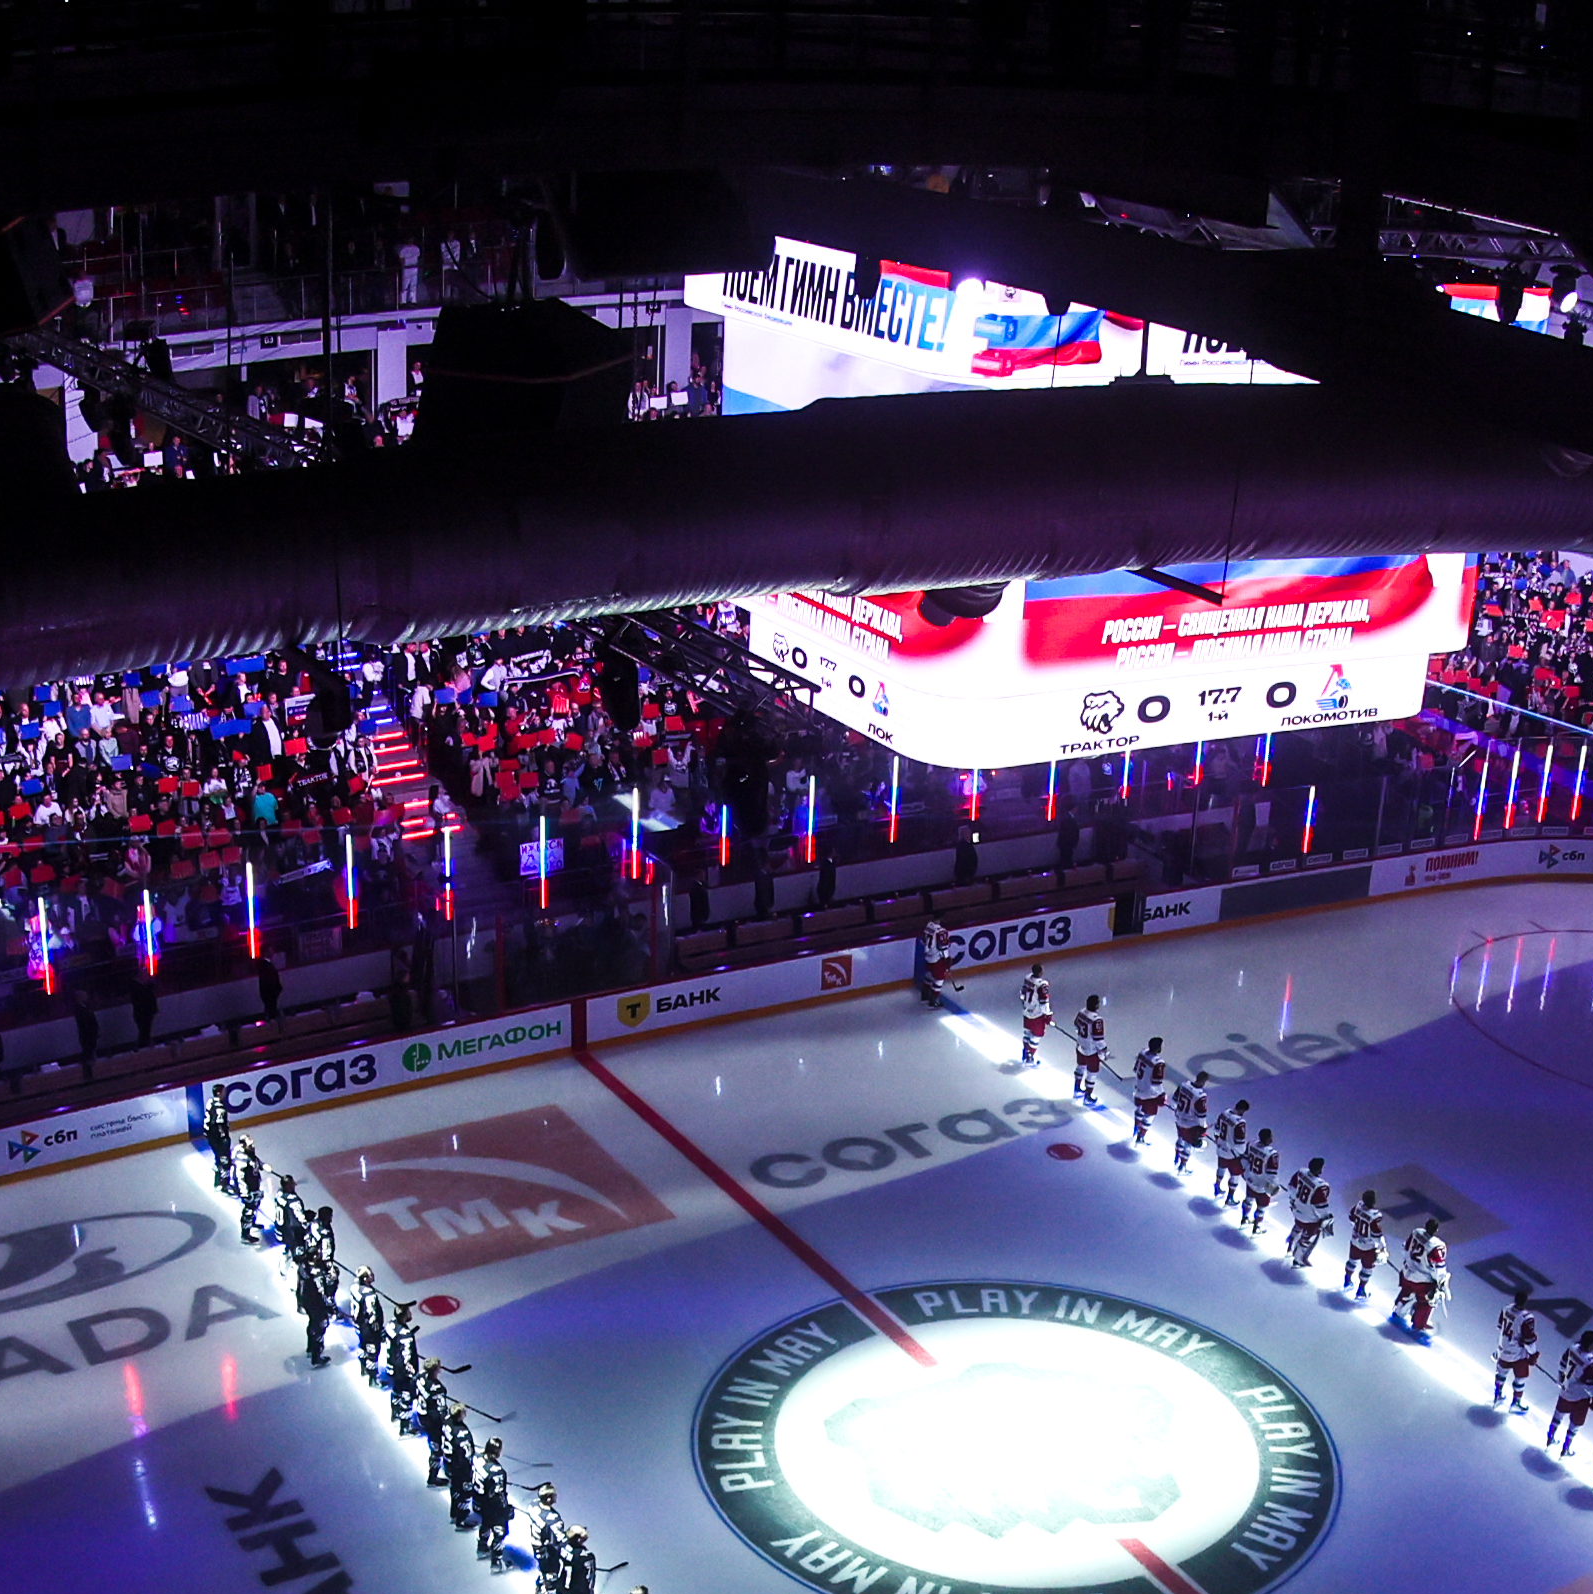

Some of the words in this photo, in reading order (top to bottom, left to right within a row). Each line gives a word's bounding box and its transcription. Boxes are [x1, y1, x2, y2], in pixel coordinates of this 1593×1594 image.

[780, 256, 841, 326] ГИМН
[840, 270, 957, 353] ВМЕСТЕ!
[1101, 616, 1164, 645] РОССИЯ
[1177, 607, 1263, 638] СВЯЩЕННАЯ
[1262, 603, 1305, 628] НАША
[1303, 599, 1370, 627] ДЕРЖАВА,
[792, 647, 807, 669] 0
[1115, 642, 1176, 671] РОССИЯ
[1188, 635, 1263, 665] ЛЮБИМАЯ
[1262, 631, 1305, 654] НАША
[848, 675, 865, 698] 0
[1197, 686, 1243, 706] 17.7
[1266, 681, 1297, 708] 0
[1137, 695, 1171, 723] 0
[1208, 711, 1229, 722] 1-й
[1280, 708, 1379, 727] ЛОКОМОТИВ
[868, 723, 894, 744] ЛОК
[1060, 735, 1140, 755] ТРАКТОР
[1424, 850, 1480, 872] ПОМНИМ!
[1562, 851, 1586, 861] сбп
[1144, 901, 1191, 922] БАНК
[949, 915, 1072, 970] согаз
[625, 1001, 643, 1020] Т
[656, 986, 723, 1014] БАНК
[437, 1020, 563, 1061] МЕГАФОН
[225, 1053, 378, 1115] согаз
[43, 1127, 78, 1148] сбп
[749, 1096, 1090, 1190] согаз
[365, 1196, 587, 1244] ТМК
[915, 1289, 1041, 1317] PLAY
[1056, 1295, 1104, 1325] IN
[1111, 1309, 1218, 1358] MAY
[763, 1320, 840, 1376] MAY
[728, 1376, 781, 1409] IN
[1234, 1383, 1320, 1460] PLAY
[710, 1410, 776, 1494] PLAY
[1270, 1464, 1321, 1499] IN
[1230, 1501, 1315, 1573] MAY
[770, 1530, 889, 1594] MAY
